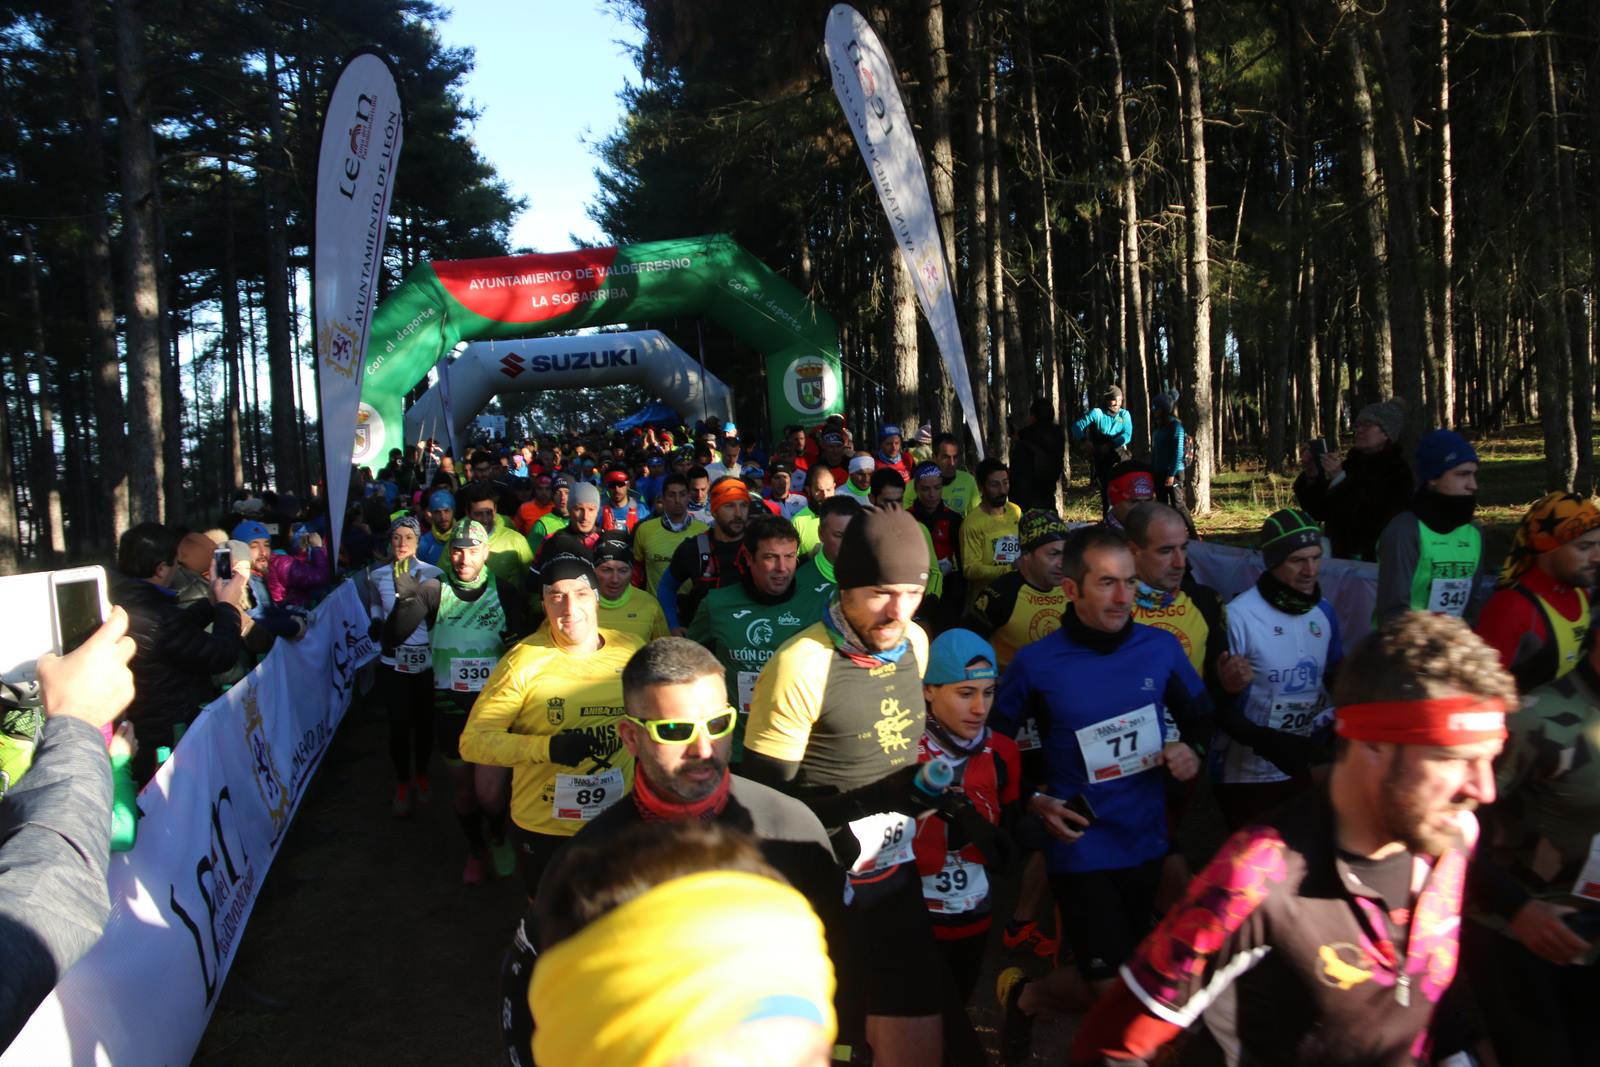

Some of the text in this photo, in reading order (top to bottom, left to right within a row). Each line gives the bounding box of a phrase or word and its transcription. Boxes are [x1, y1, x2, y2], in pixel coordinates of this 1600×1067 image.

[354, 111, 397, 328] AYUNTAMIENTO DE LEÓN
[469, 257, 691, 291] AYUNTAMIENTO DE VALDEFRESNO
[531, 287, 629, 309] LA SOBARRIBA
[728, 278, 802, 332] Con el deporte
[366, 308, 436, 376] Con el deporte
[531, 348, 638, 373] SUZUKI
[1001, 542, 1020, 552] 280
[1440, 591, 1467, 607] 343
[402, 654, 426, 664] 159
[729, 646, 756, 661] LEÓN
[459, 667, 490, 680] 330
[1106, 730, 1138, 758] 77
[576, 787, 606, 805] 89
[935, 869, 968, 893] 39
